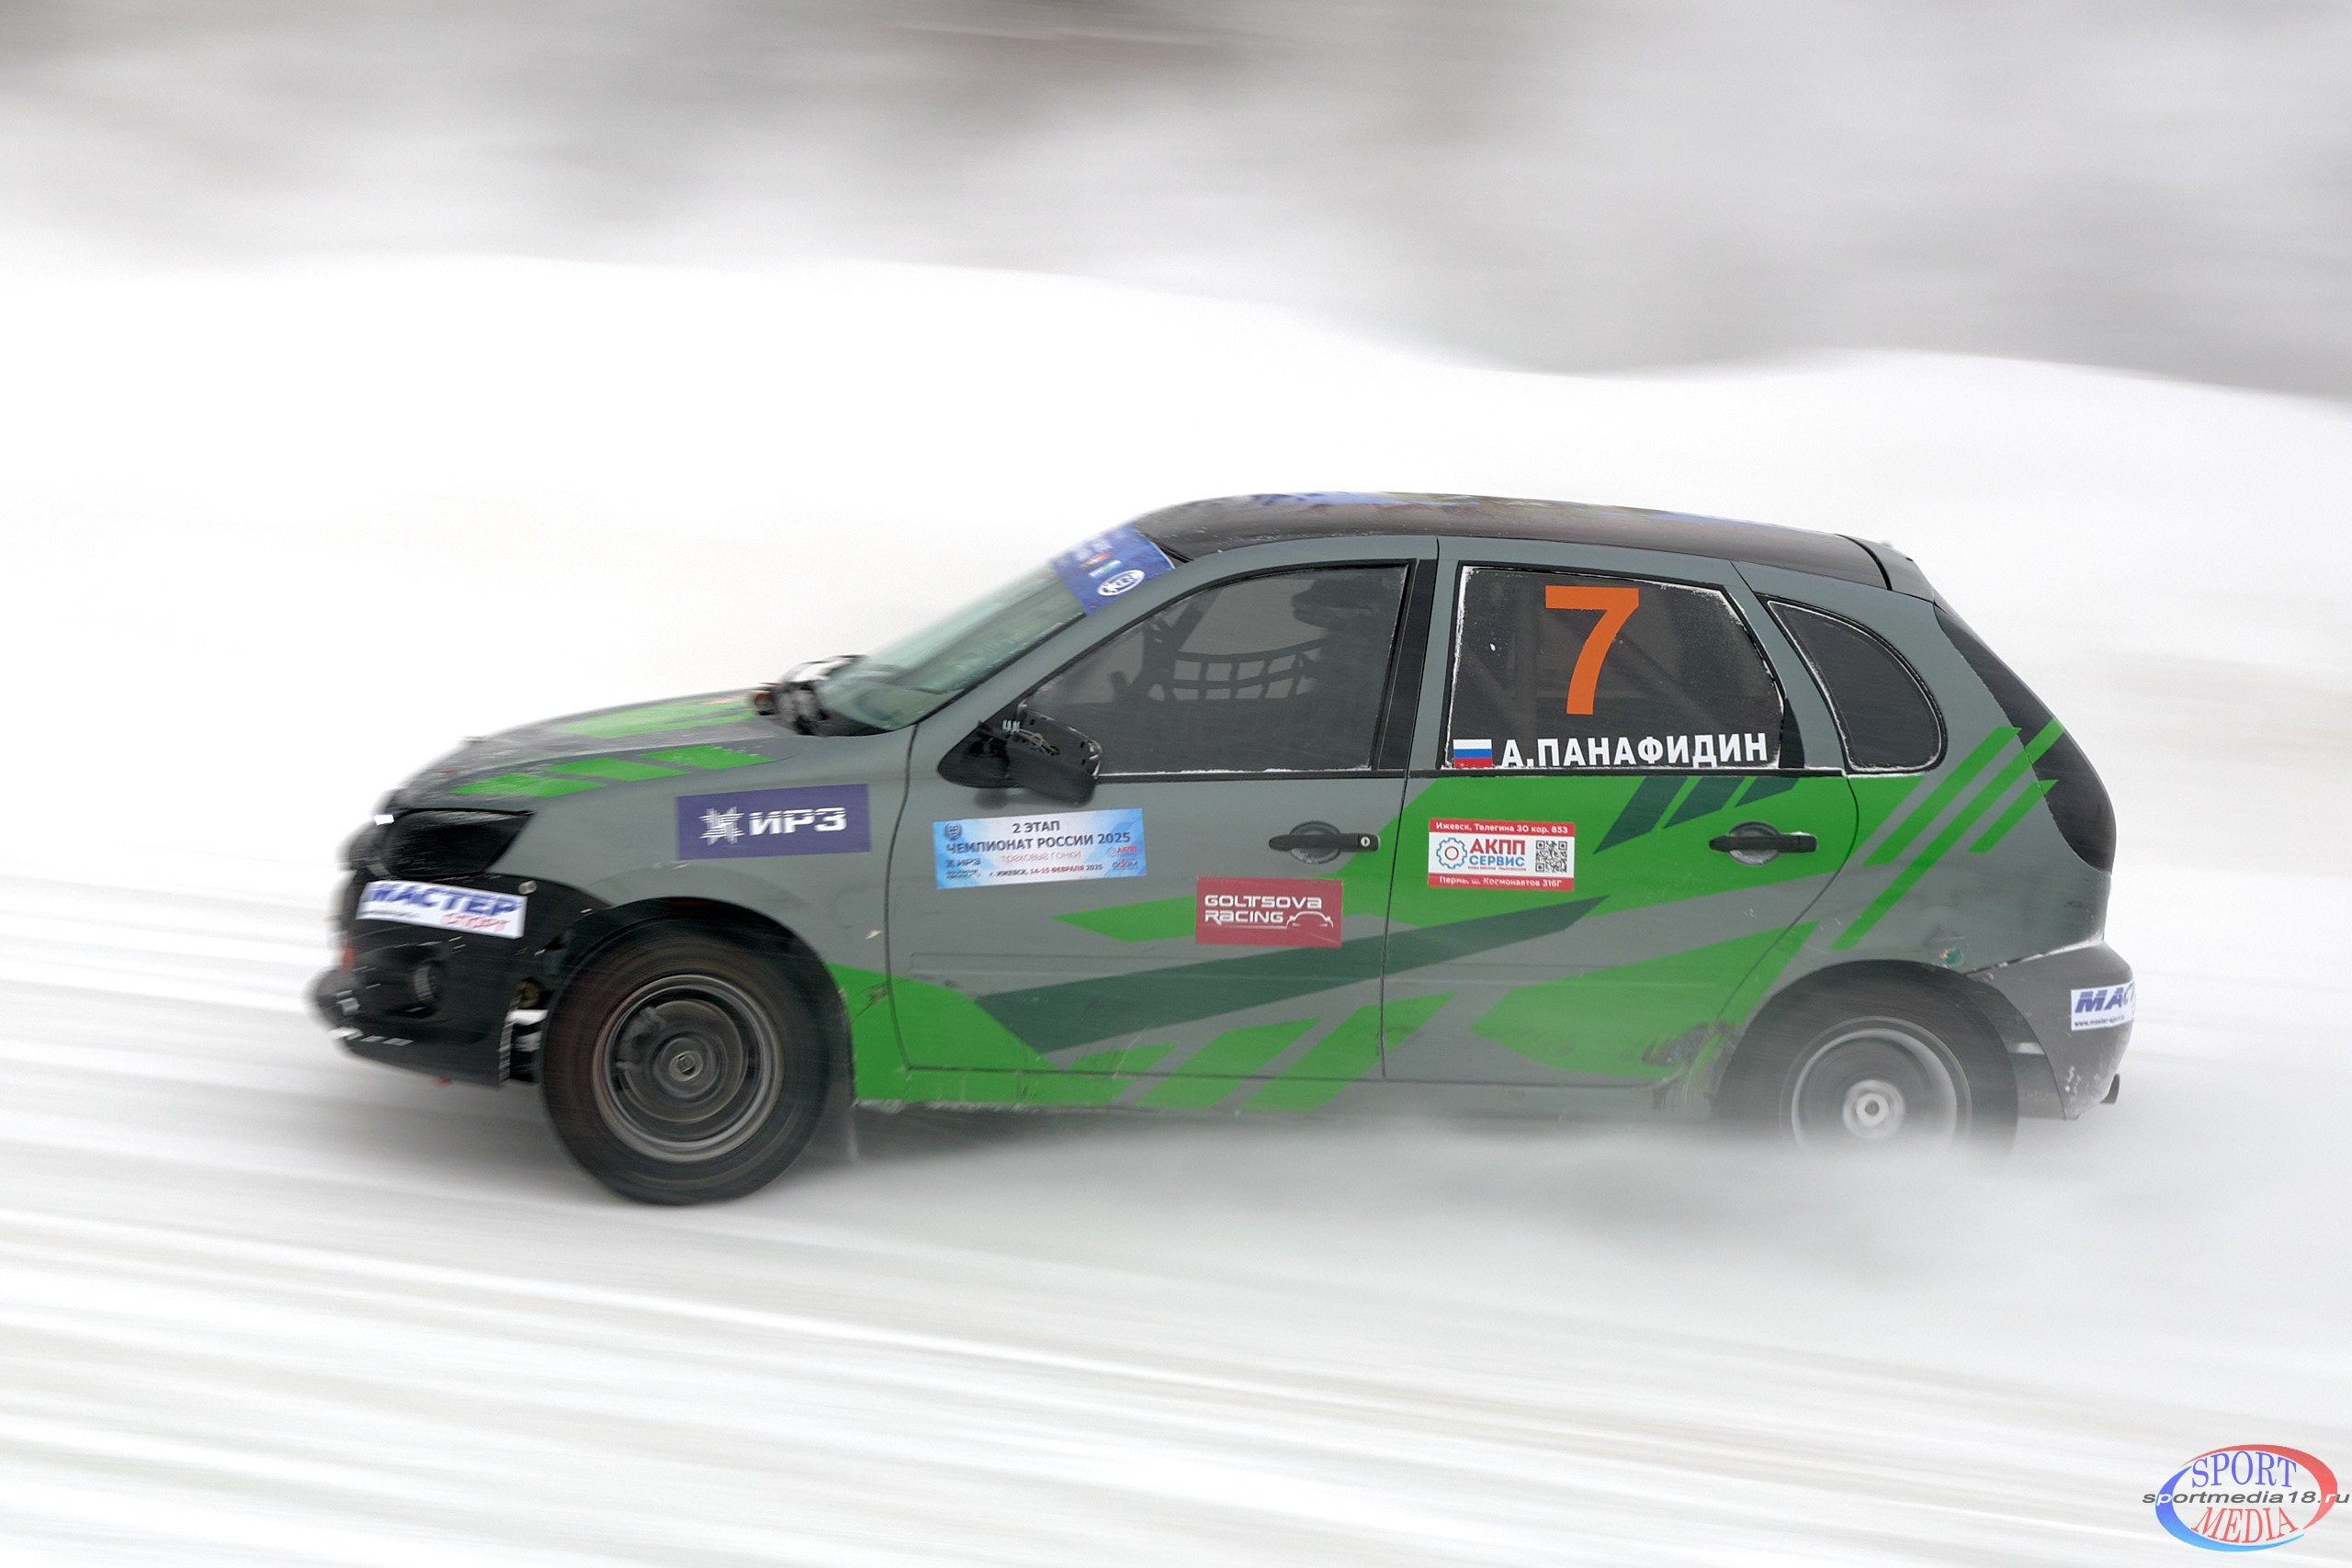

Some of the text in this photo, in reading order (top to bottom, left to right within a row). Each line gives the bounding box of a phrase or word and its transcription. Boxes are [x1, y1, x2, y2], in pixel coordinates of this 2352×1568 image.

[1545, 585, 1639, 715] 7
[1501, 733, 1767, 768] А.ПАНАФИДИН
[749, 807, 847, 836] ИРЗ
[1012, 820, 1060, 834] 2 ЭТАП
[1474, 823, 1514, 832] Телегина
[1517, 824, 1529, 832] 30
[1531, 826, 1549, 834] кор.
[1551, 826, 1568, 834] 853
[946, 832, 1131, 854] ЧЕМПИОНАТ РОССИИ 2025
[1470, 838, 1526, 855] АКПП
[1469, 855, 1525, 867] СЕРВИС
[1483, 877, 1540, 887] Космонавтов
[368, 883, 522, 917] МАСТЕР
